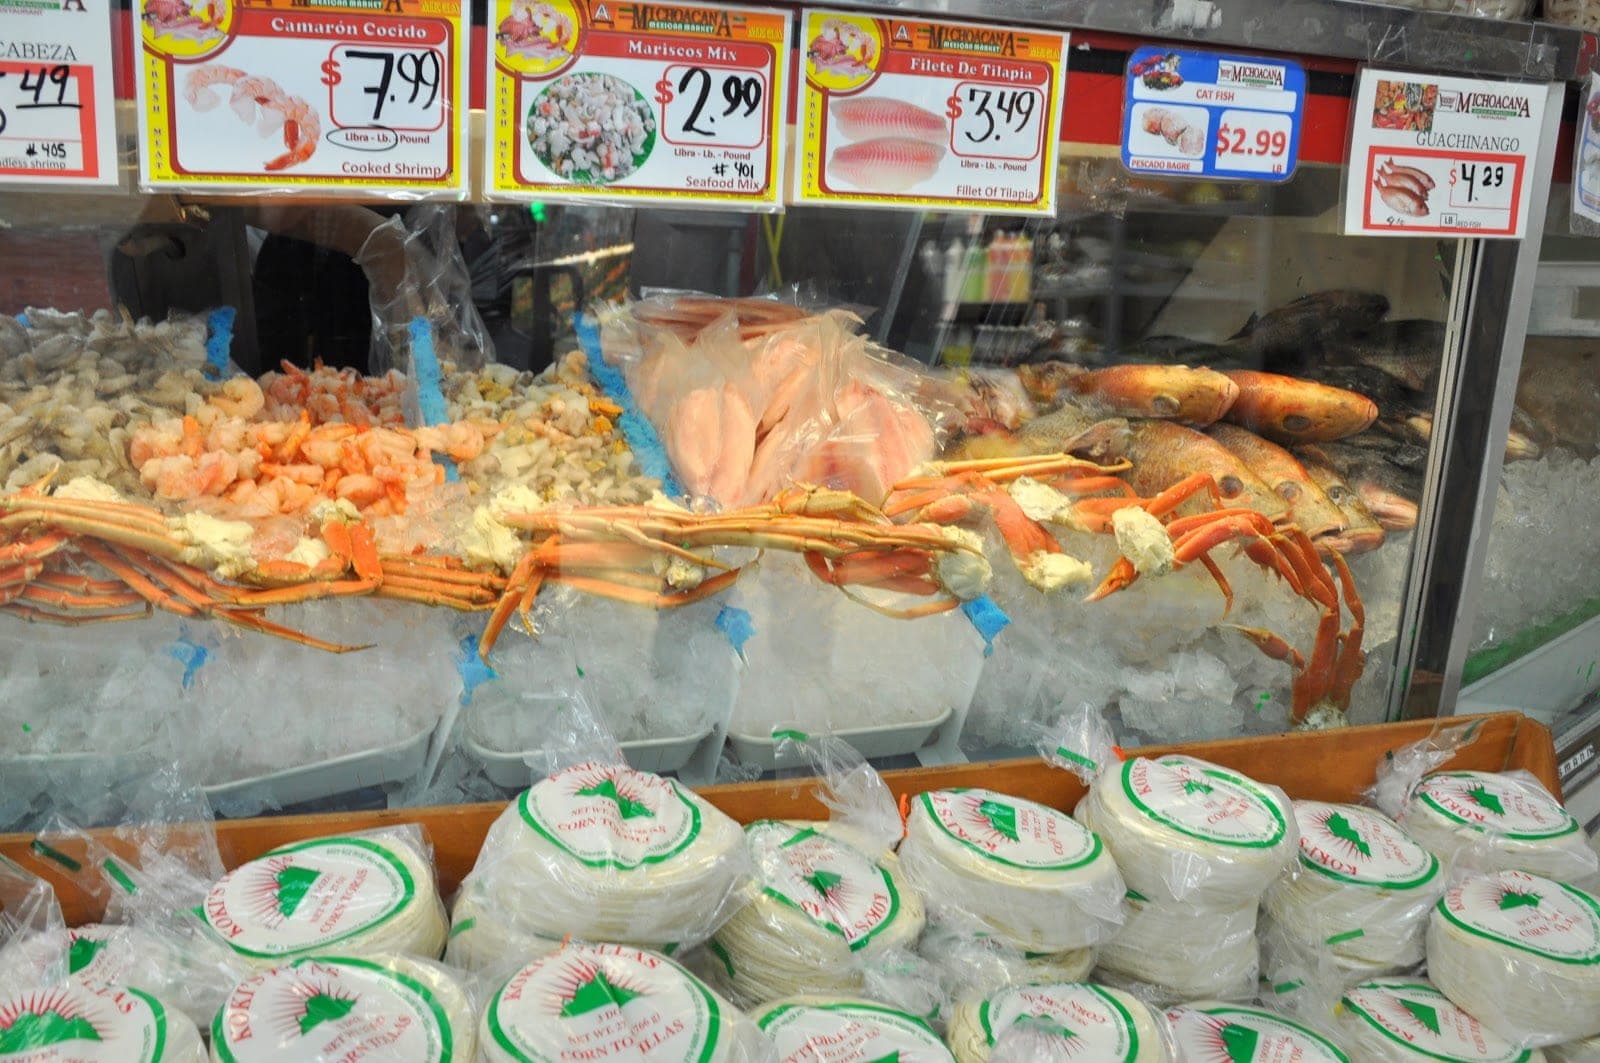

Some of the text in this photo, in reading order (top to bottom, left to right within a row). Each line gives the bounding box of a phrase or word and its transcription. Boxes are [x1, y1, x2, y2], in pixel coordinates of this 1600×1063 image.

[271, 17, 427, 39] Camarón Cocido
[631, 5, 732, 37] MICHOACANA
[628, 40, 737, 61] Mariscos Mix
[928, 24, 1016, 57] MICHOACANA
[911, 57, 1033, 81] Filete De Tilapia
[1232, 64, 1282, 86] MICHOACANA
[1196, 89, 1235, 101] CAT FISH
[1456, 91, 1531, 118] MICHOACANA
[345, 132, 369, 142] Libra
[399, 134, 430, 144] Pound
[1216, 122, 1287, 157] $2.99
[1416, 131, 1520, 152] GUACHINANGO
[30, 158, 67, 171] shrimp
[674, 148, 695, 158] Libra
[723, 150, 751, 161] Pound
[1131, 159, 1191, 171] PESCADO BAGRE
[341, 161, 441, 178] Cooked Shrimp
[960, 160, 979, 169] Libra
[1003, 162, 1027, 172] Pound
[1272, 163, 1282, 174] LB
[685, 175, 760, 190] Seafood Mix
[956, 184, 1034, 200] Fillet Of Tilapia
[207, 886, 244, 939] KOKI'S
[229, 975, 265, 1044] KOKI'S
